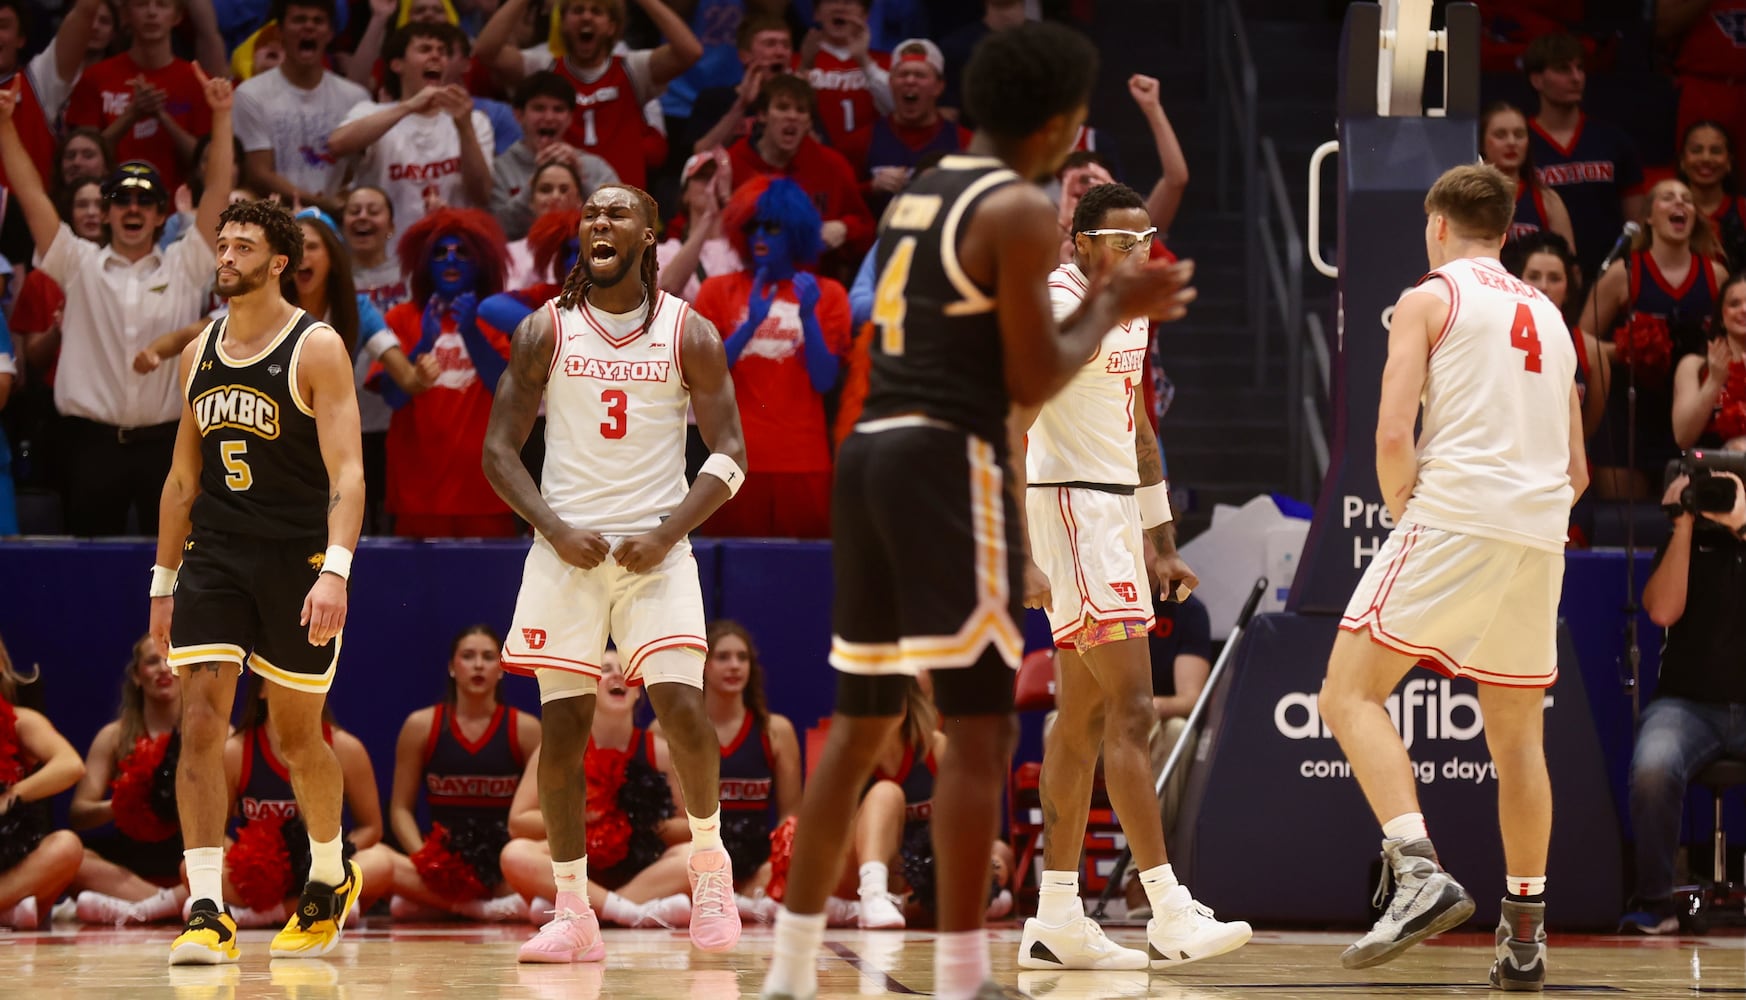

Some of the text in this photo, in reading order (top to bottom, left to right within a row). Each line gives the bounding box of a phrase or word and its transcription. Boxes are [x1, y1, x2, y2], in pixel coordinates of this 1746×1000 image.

[583, 109, 598, 147] 1
[839, 99, 856, 132] 1
[871, 235, 917, 357] 4
[1510, 302, 1542, 374] 4
[565, 355, 670, 382] DAYTON
[193, 384, 281, 441] UMBC
[600, 389, 628, 440] 3
[220, 440, 253, 492] 5
